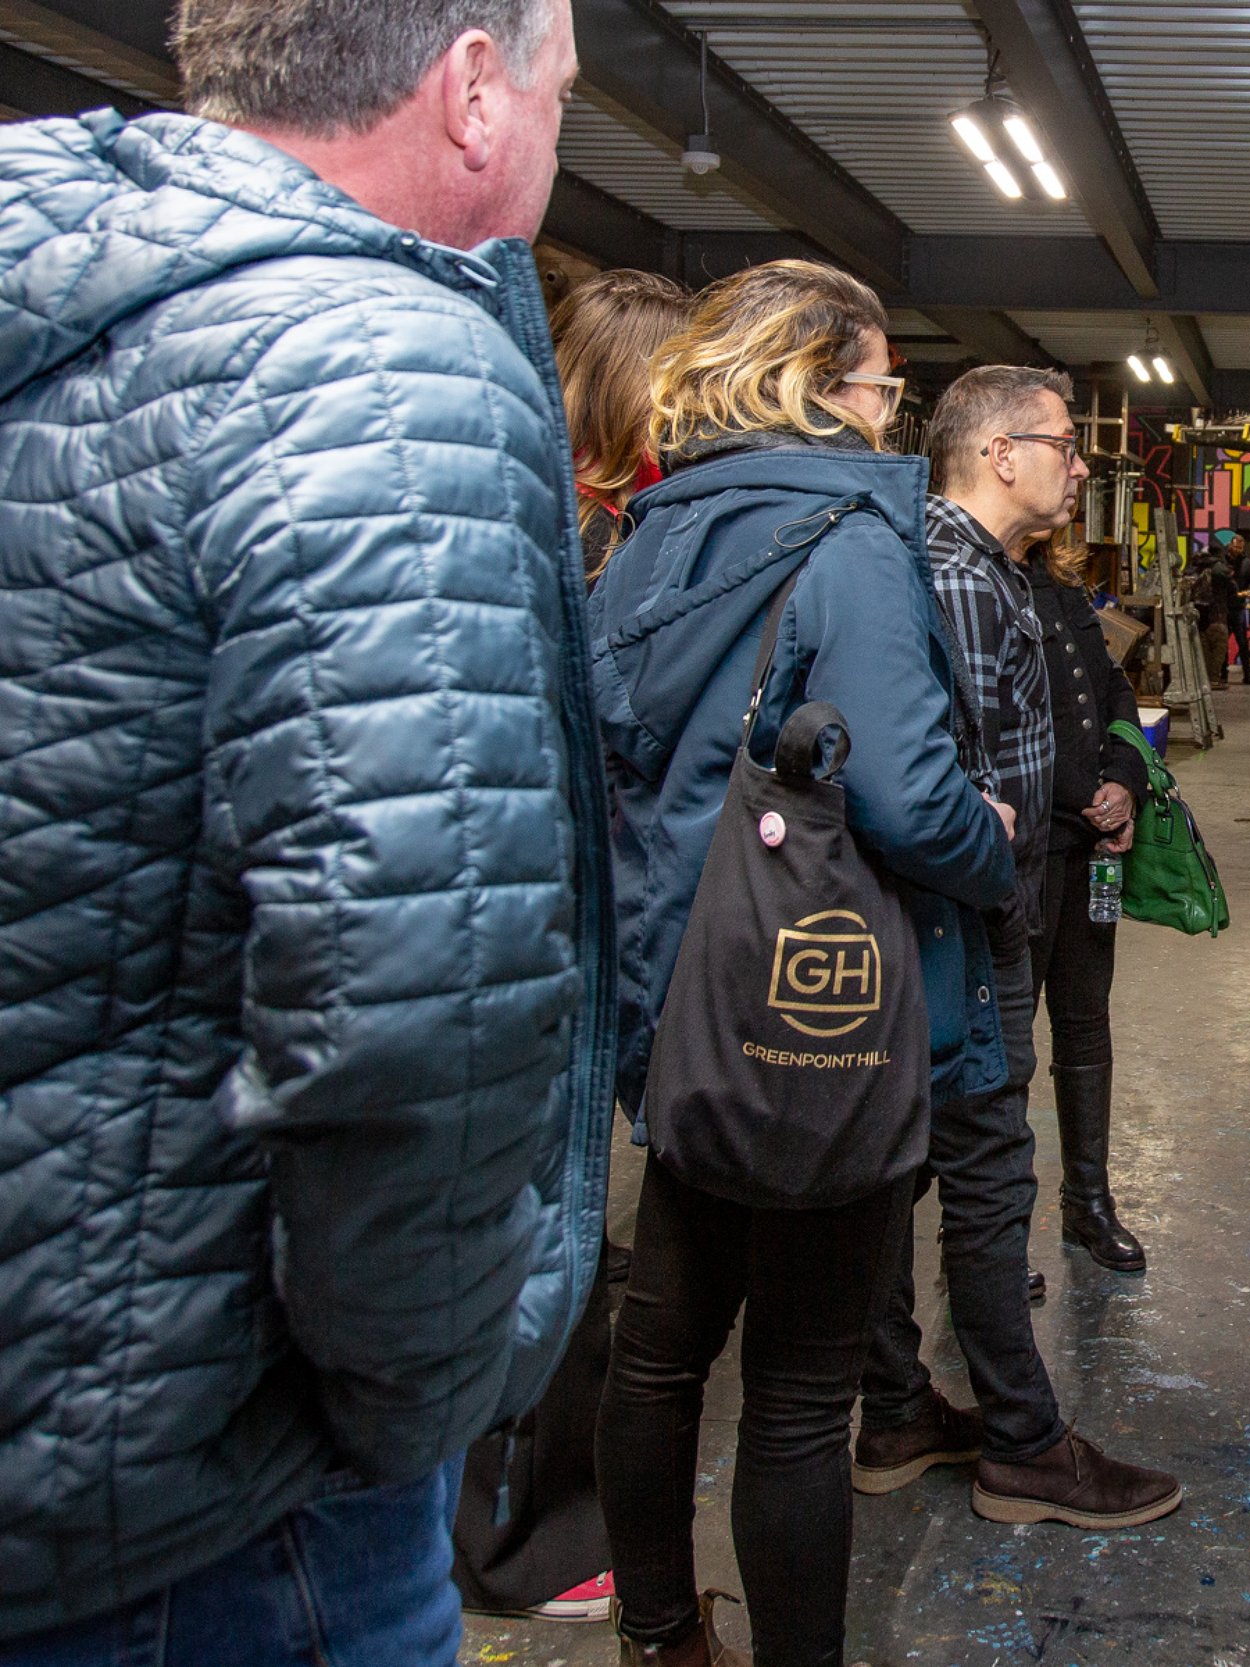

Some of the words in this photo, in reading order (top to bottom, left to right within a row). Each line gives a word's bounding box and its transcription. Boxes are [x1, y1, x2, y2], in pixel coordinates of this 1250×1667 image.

[786, 948, 870, 996] GH
[742, 1041, 856, 1069] GREENPOINT
[856, 1050, 891, 1068] HILL
